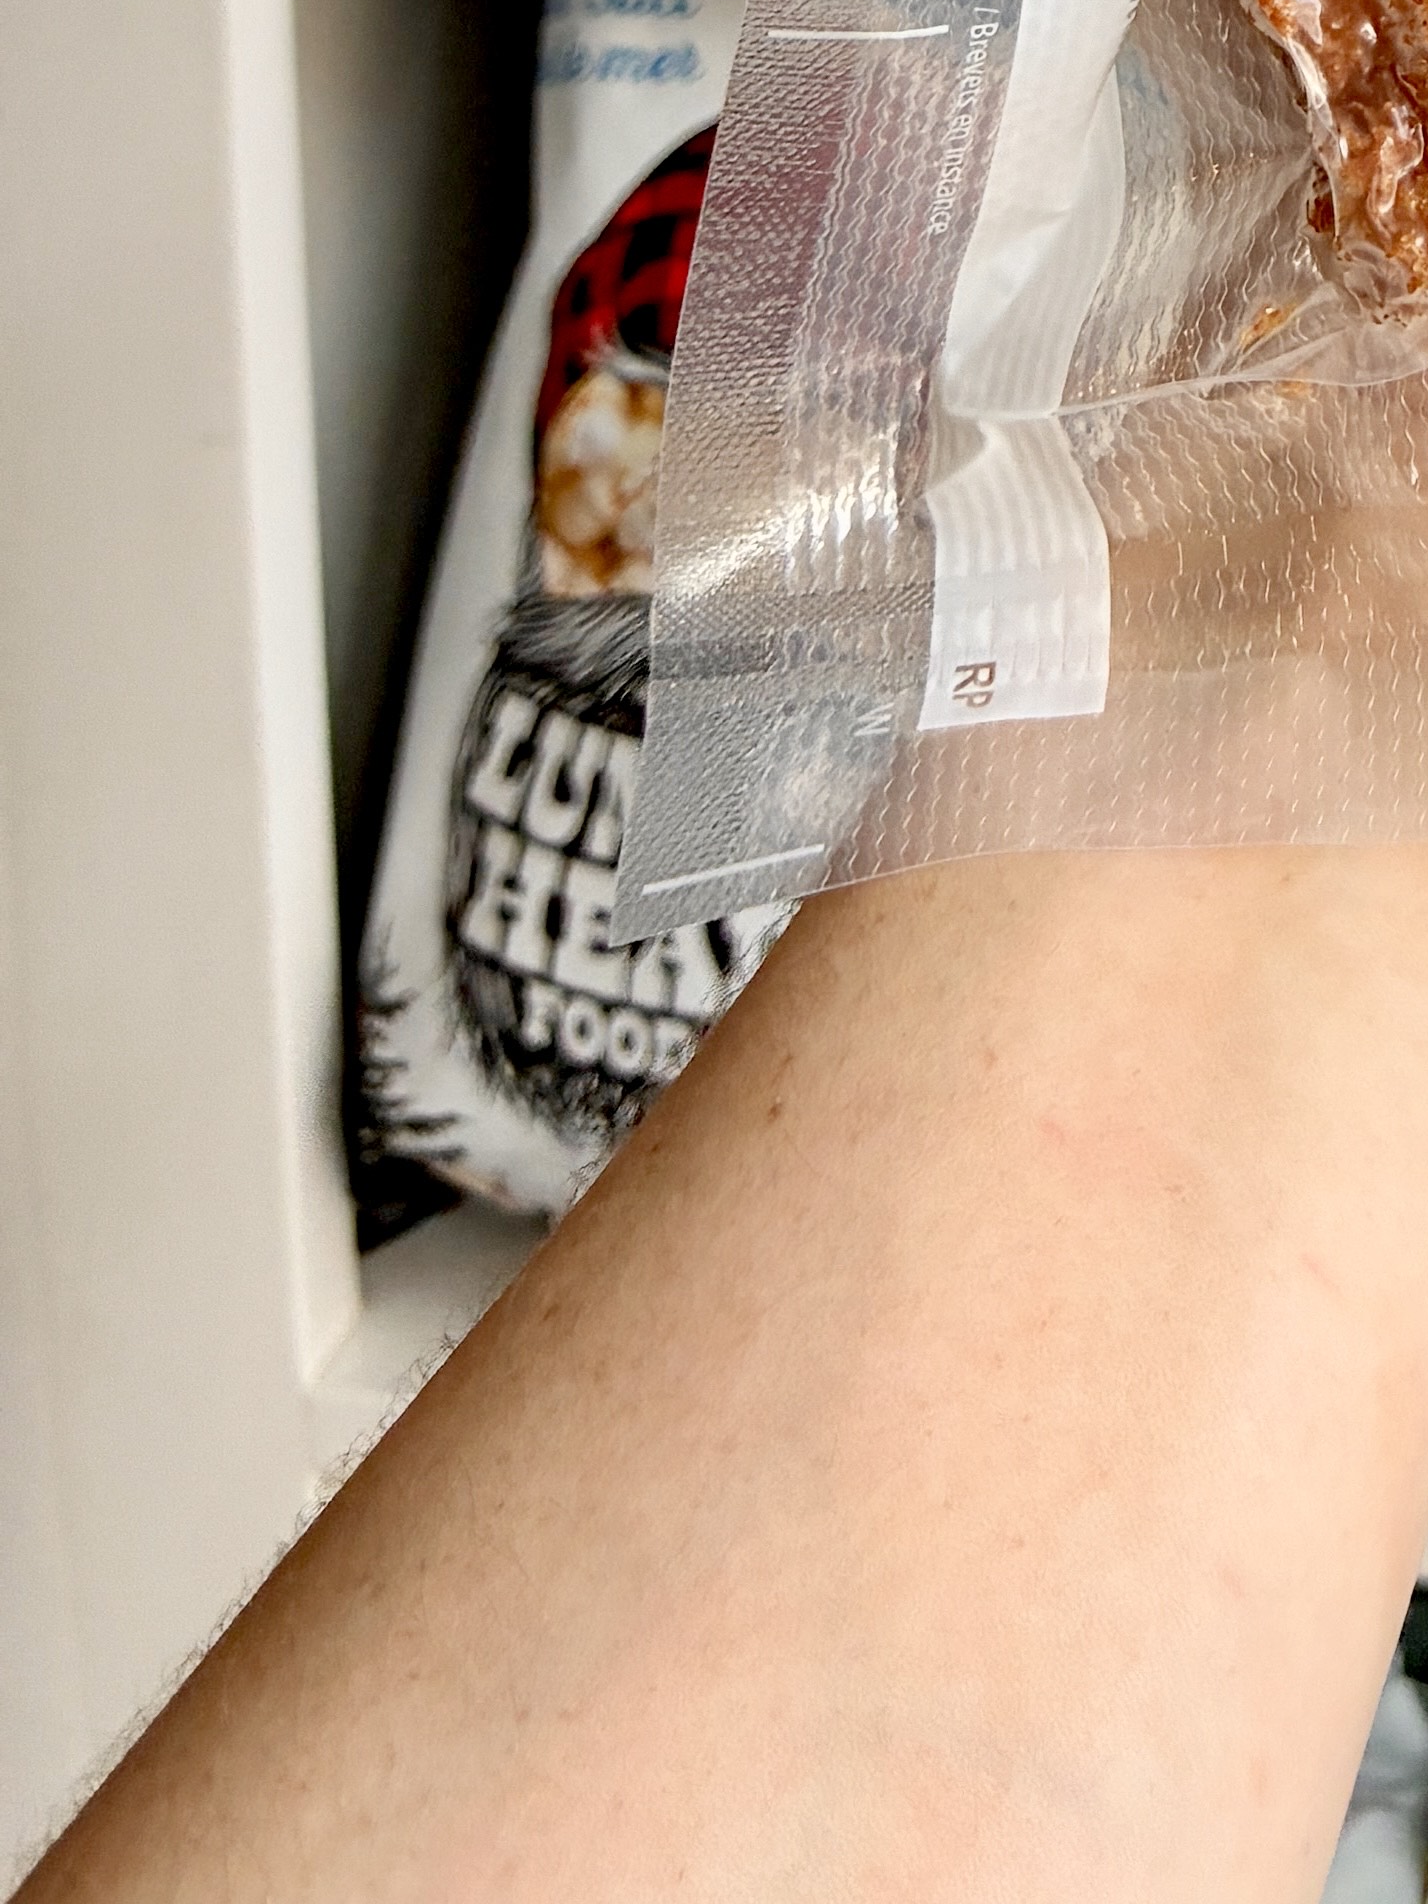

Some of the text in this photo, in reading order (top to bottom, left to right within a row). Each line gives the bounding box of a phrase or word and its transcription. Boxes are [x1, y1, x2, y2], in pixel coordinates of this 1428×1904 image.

[960, 19, 1000, 108] Brevets
[947, 108, 974, 143] en
[928, 135, 966, 236] instance
[952, 660, 998, 709] RP
